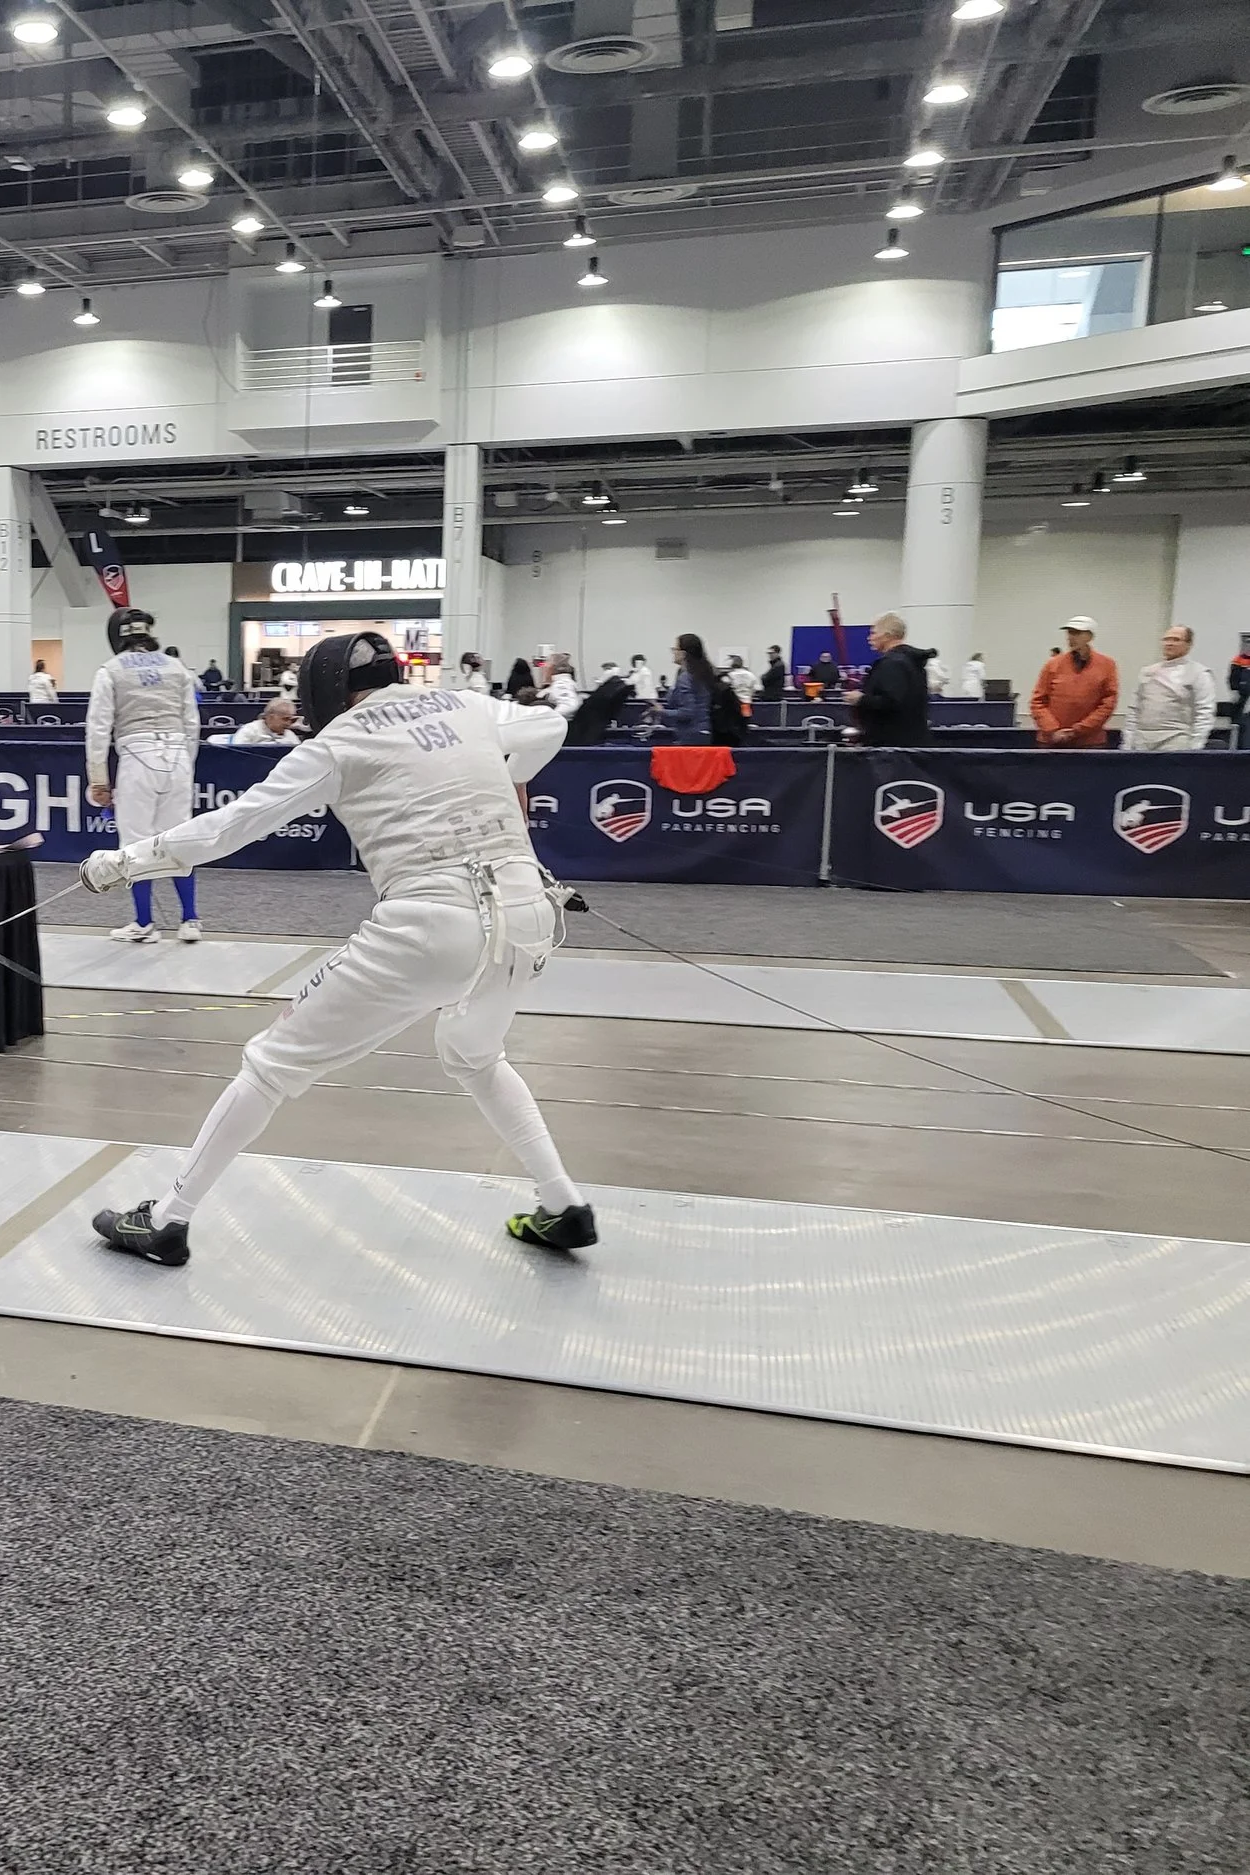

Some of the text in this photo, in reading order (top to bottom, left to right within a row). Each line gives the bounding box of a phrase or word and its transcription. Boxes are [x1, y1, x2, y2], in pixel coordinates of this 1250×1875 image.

[36, 422, 177, 450] RESTROOMS
[88, 532, 104, 553] L
[407, 721, 463, 752] USA
[671, 797, 771, 818] USA
[964, 801, 1076, 823] USA
[661, 822, 781, 834] PARAFENCING
[973, 827, 1062, 839] FENCING
